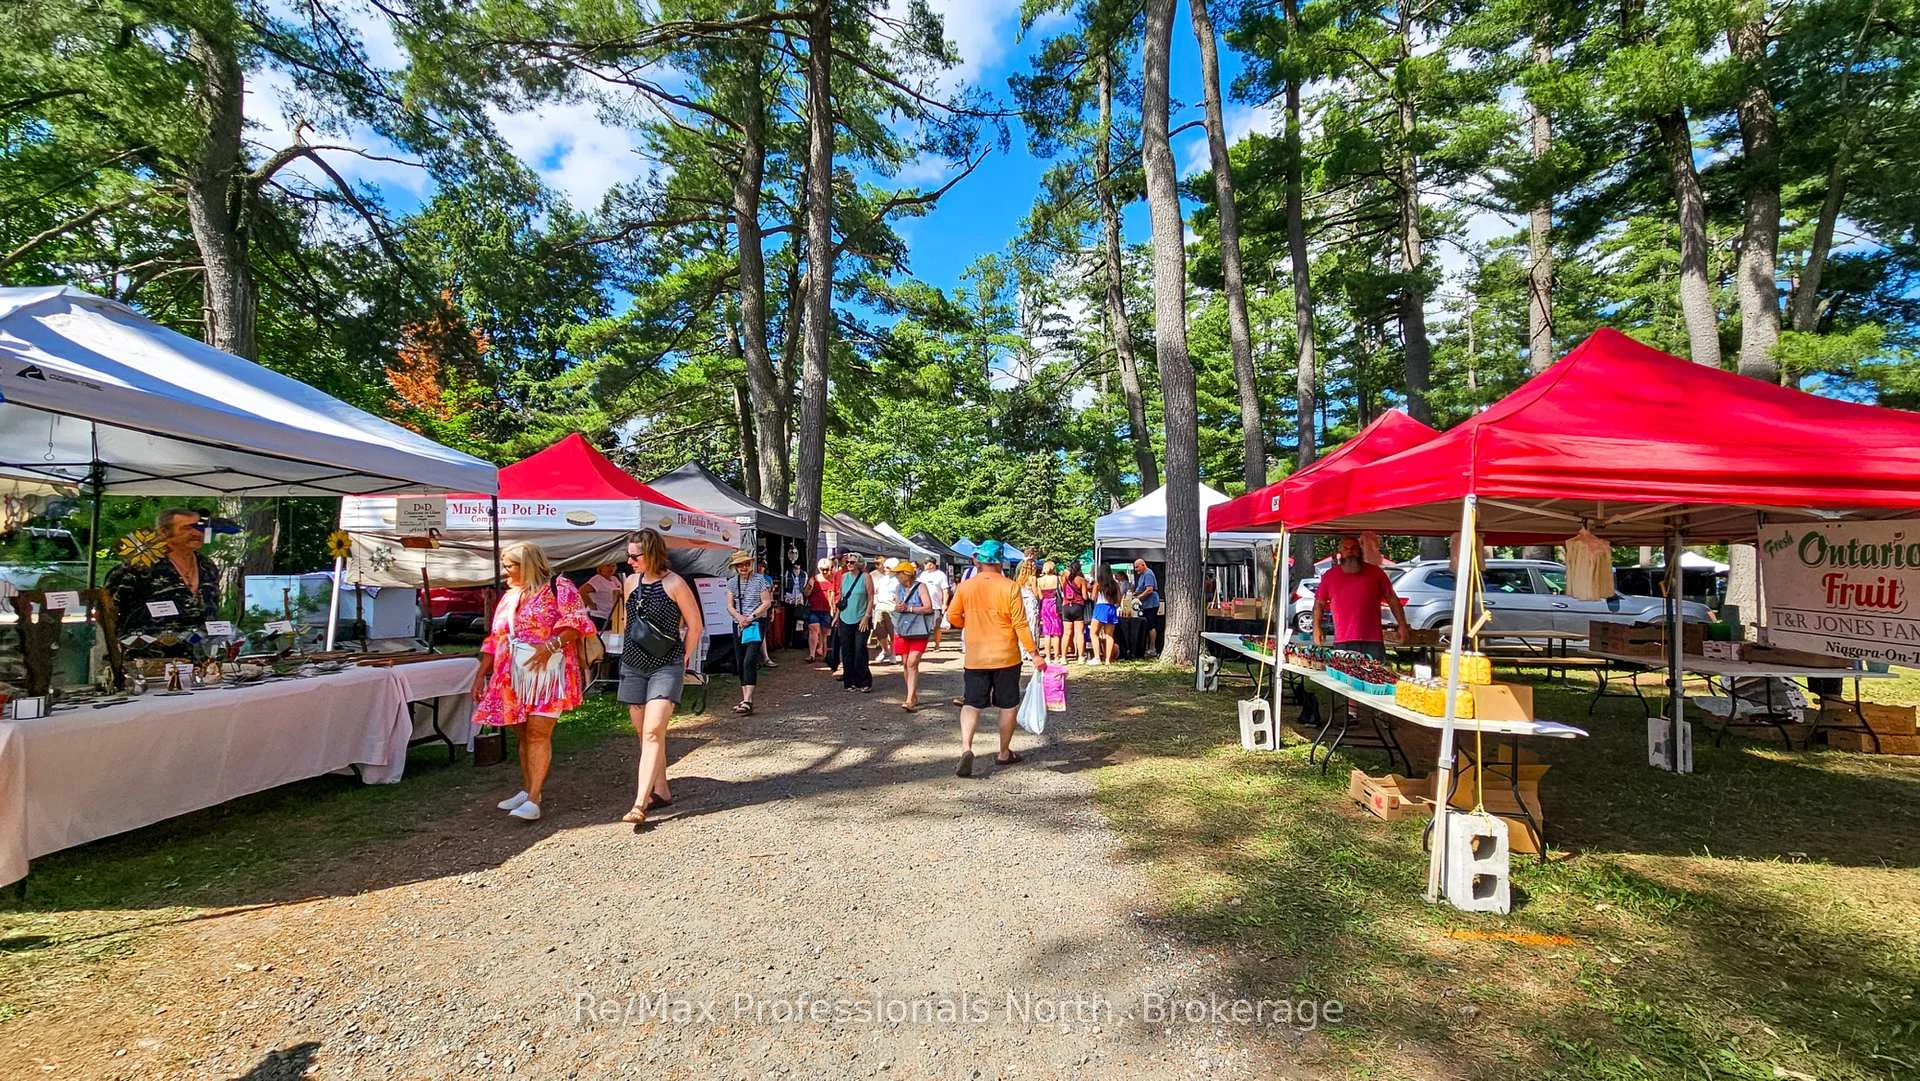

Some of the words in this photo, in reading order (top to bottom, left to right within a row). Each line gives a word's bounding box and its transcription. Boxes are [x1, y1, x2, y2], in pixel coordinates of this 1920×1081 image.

[452, 503, 507, 515] Muskoa
[512, 503, 532, 515] Pot
[537, 503, 557, 516] Pie
[1763, 530, 1794, 559] Fresh
[1798, 530, 1920, 569] Ontario
[1821, 572, 1908, 614] Fruit
[1772, 611, 1808, 629] T&R
[1814, 615, 1876, 636] JONES
